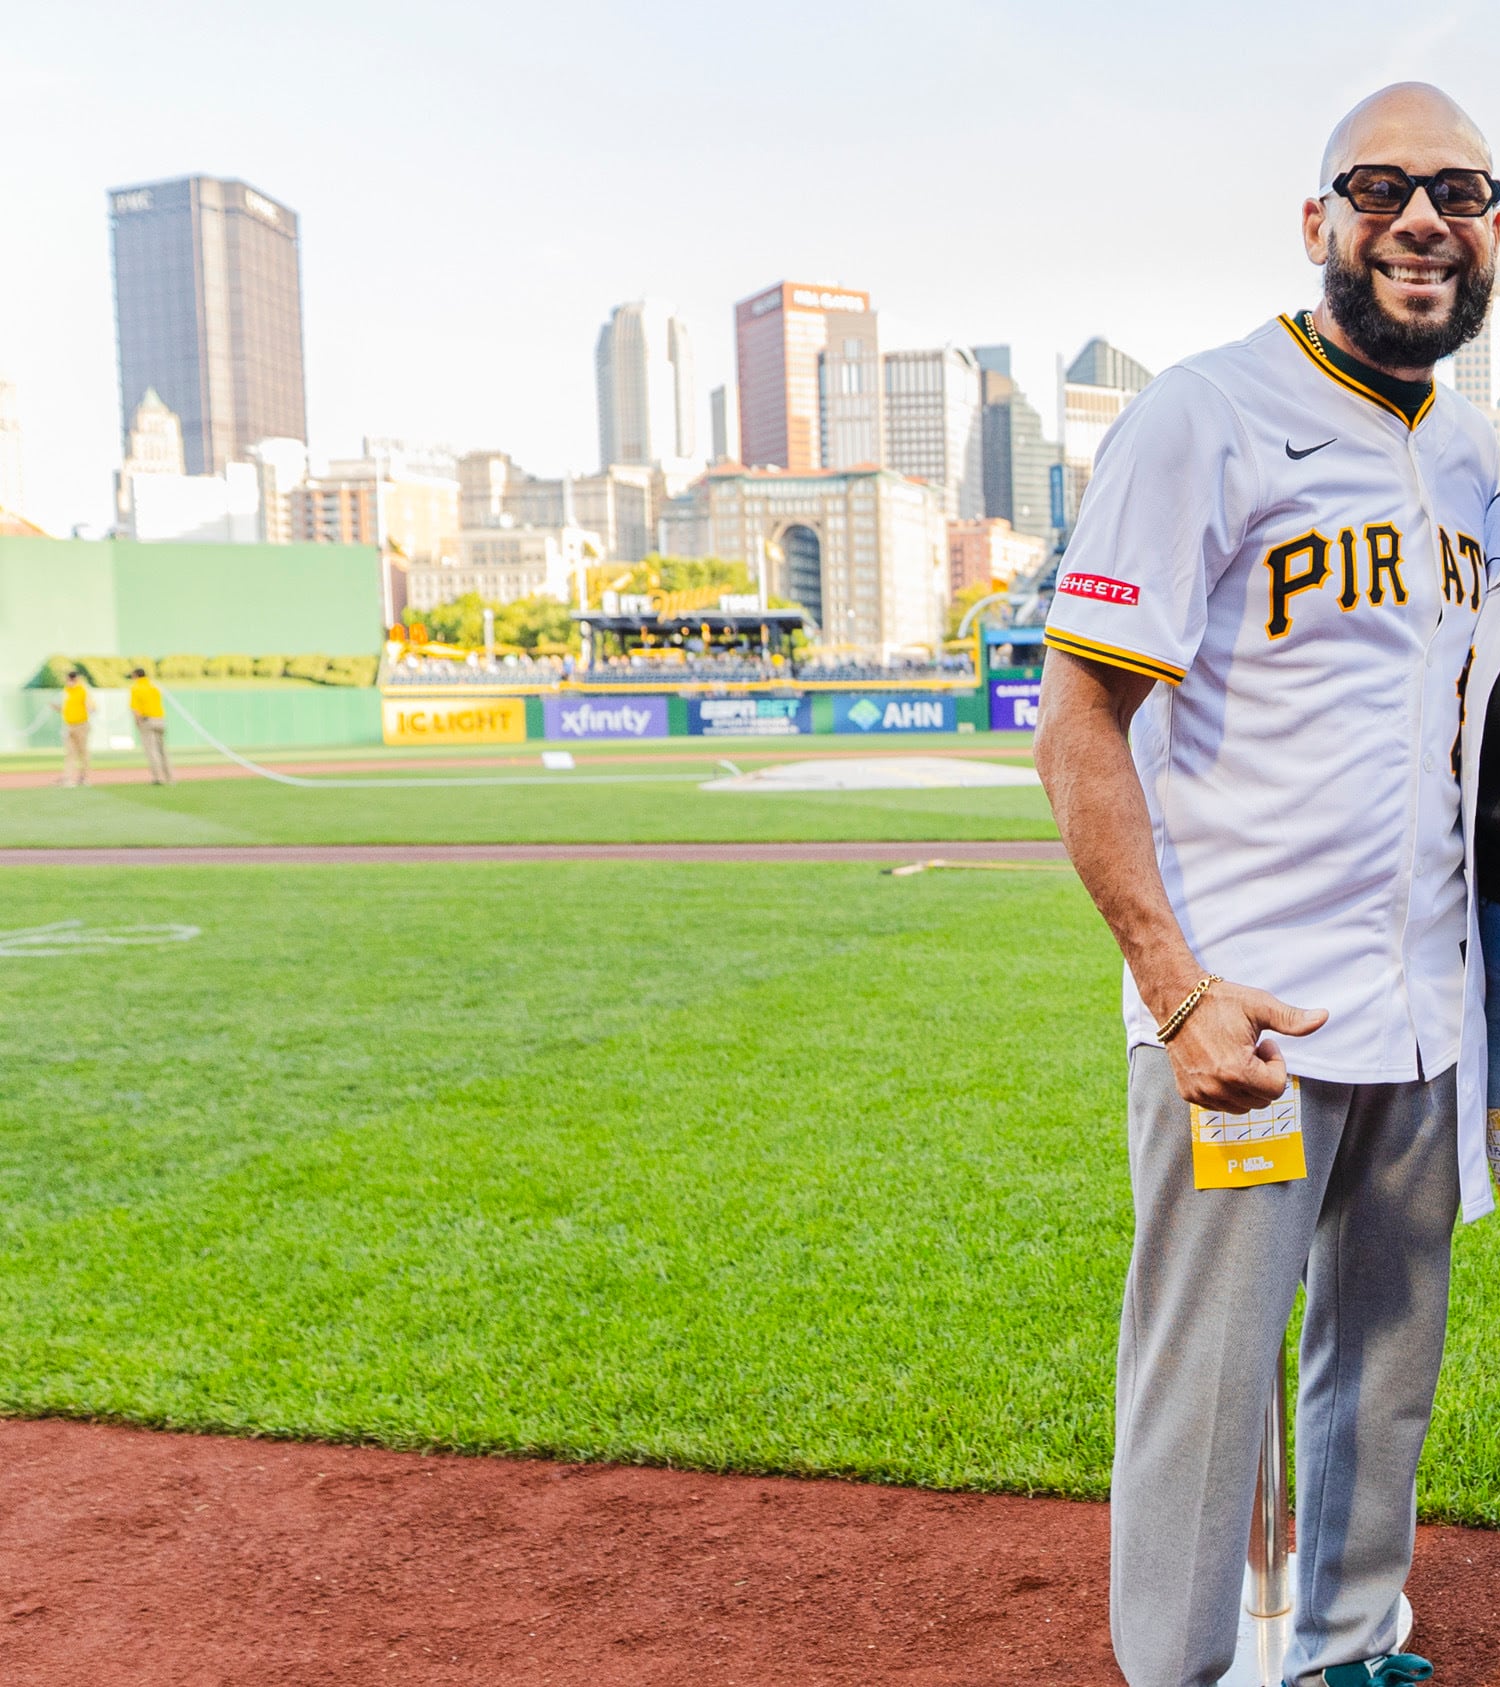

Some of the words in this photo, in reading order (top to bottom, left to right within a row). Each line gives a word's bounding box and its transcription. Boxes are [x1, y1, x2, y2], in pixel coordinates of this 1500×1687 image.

[1060, 576, 1134, 601] SHEETZ
[432, 711, 512, 735] LIGHT
[562, 704, 652, 736] xfinity
[882, 702, 944, 729] AHN
